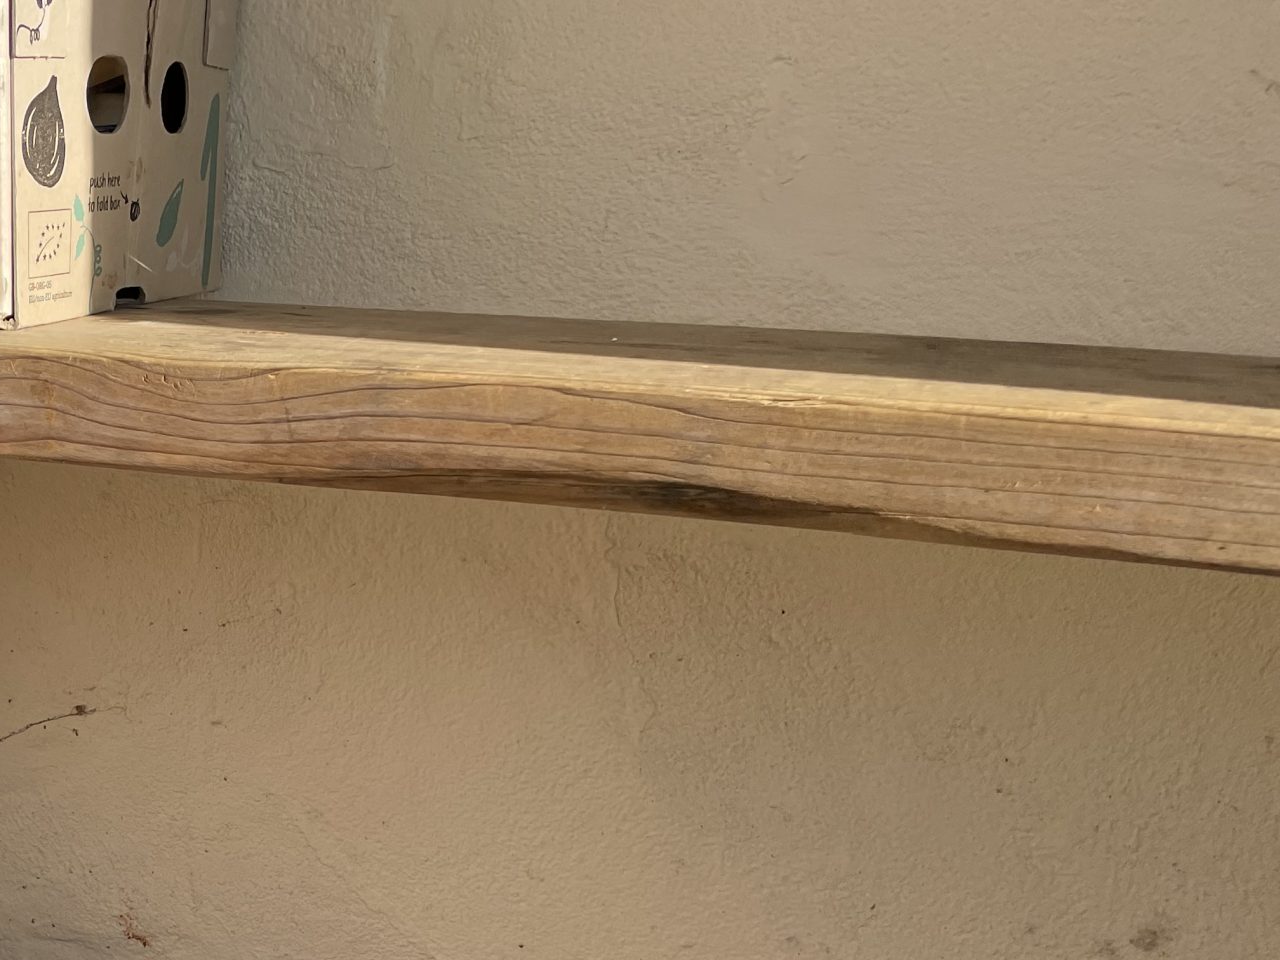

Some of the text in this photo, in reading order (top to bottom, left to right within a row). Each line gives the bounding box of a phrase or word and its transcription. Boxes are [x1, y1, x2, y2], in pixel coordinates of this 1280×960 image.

[89, 172, 121, 194] push here
[88, 195, 121, 212] to fold box
